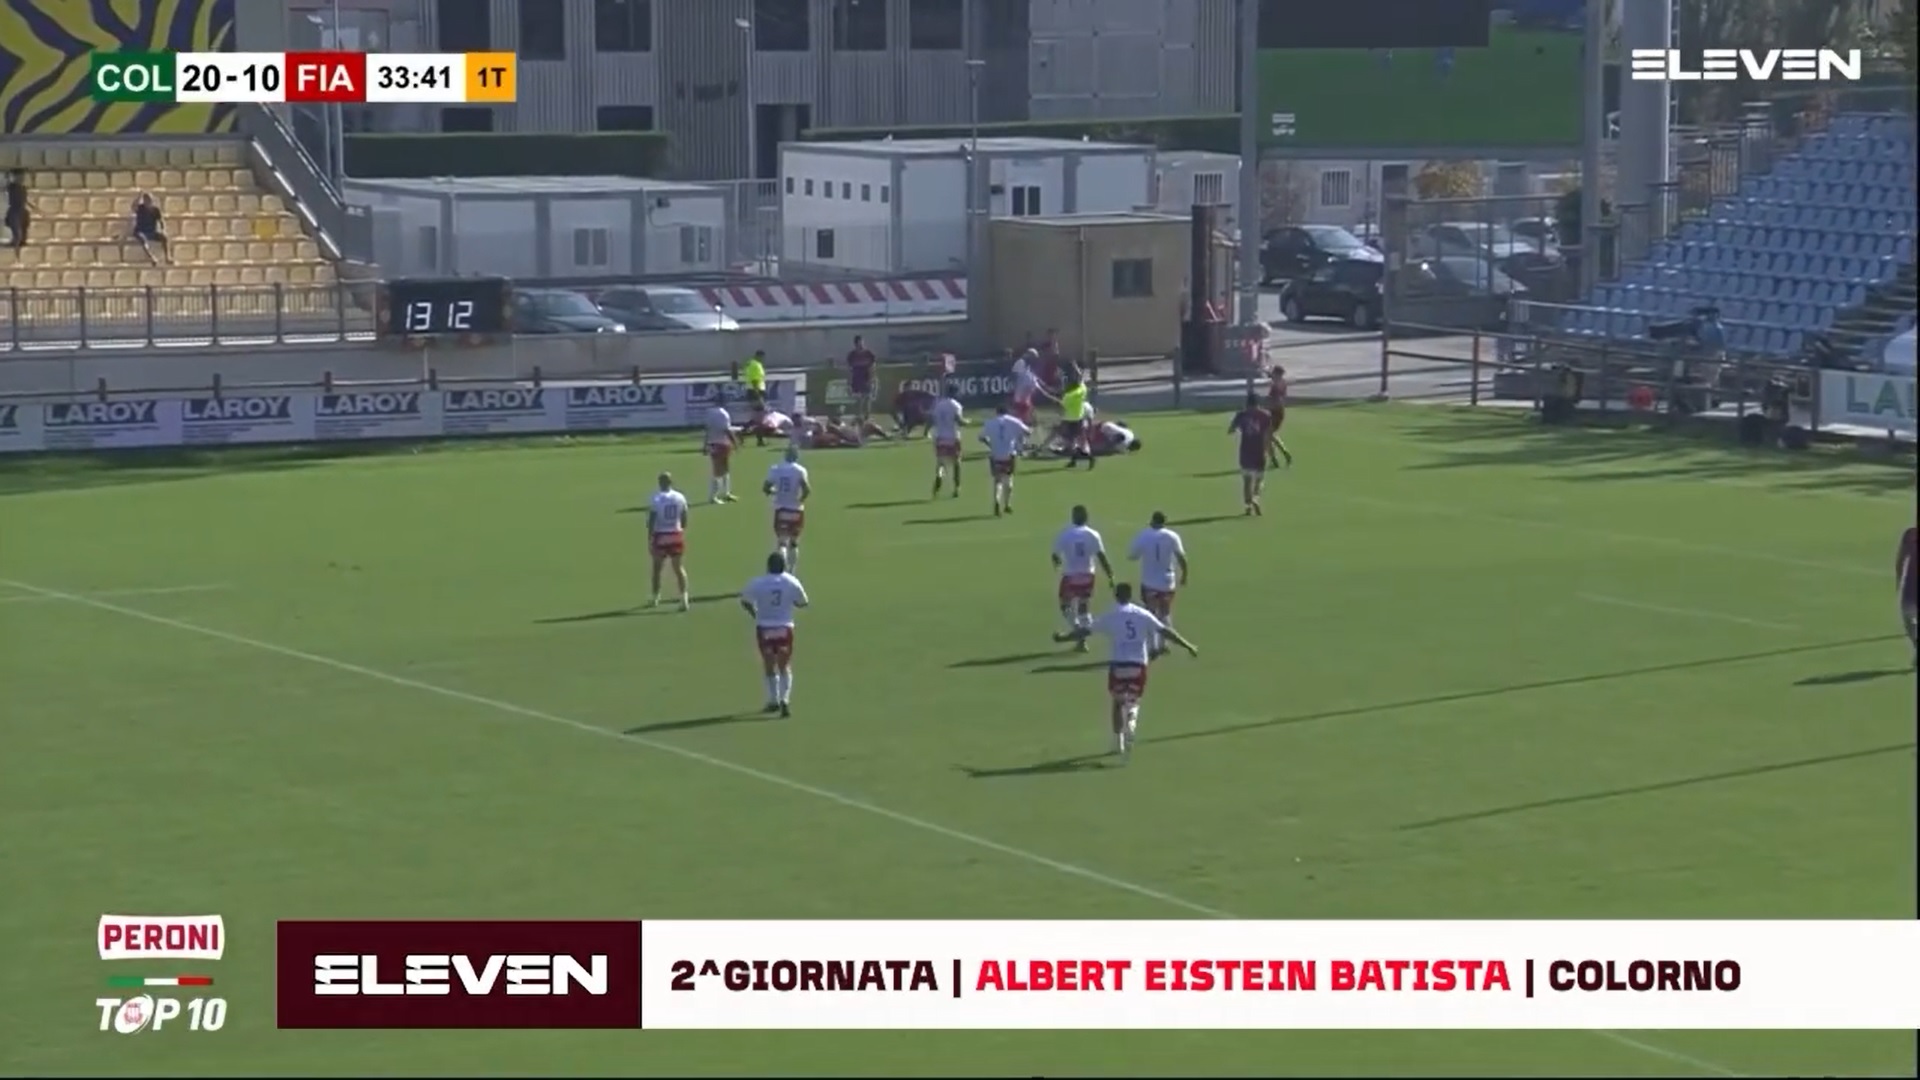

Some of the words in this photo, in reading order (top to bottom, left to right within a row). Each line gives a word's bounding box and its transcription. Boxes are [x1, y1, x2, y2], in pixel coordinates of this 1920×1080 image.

[316, 393, 416, 415] LAROY
[444, 389, 539, 410] LAROY
[569, 385, 661, 406] LAROY
[46, 401, 151, 424] LAROY
[183, 398, 287, 419] LAROY
[771, 589, 782, 607] 3
[1125, 620, 1137, 641] 5
